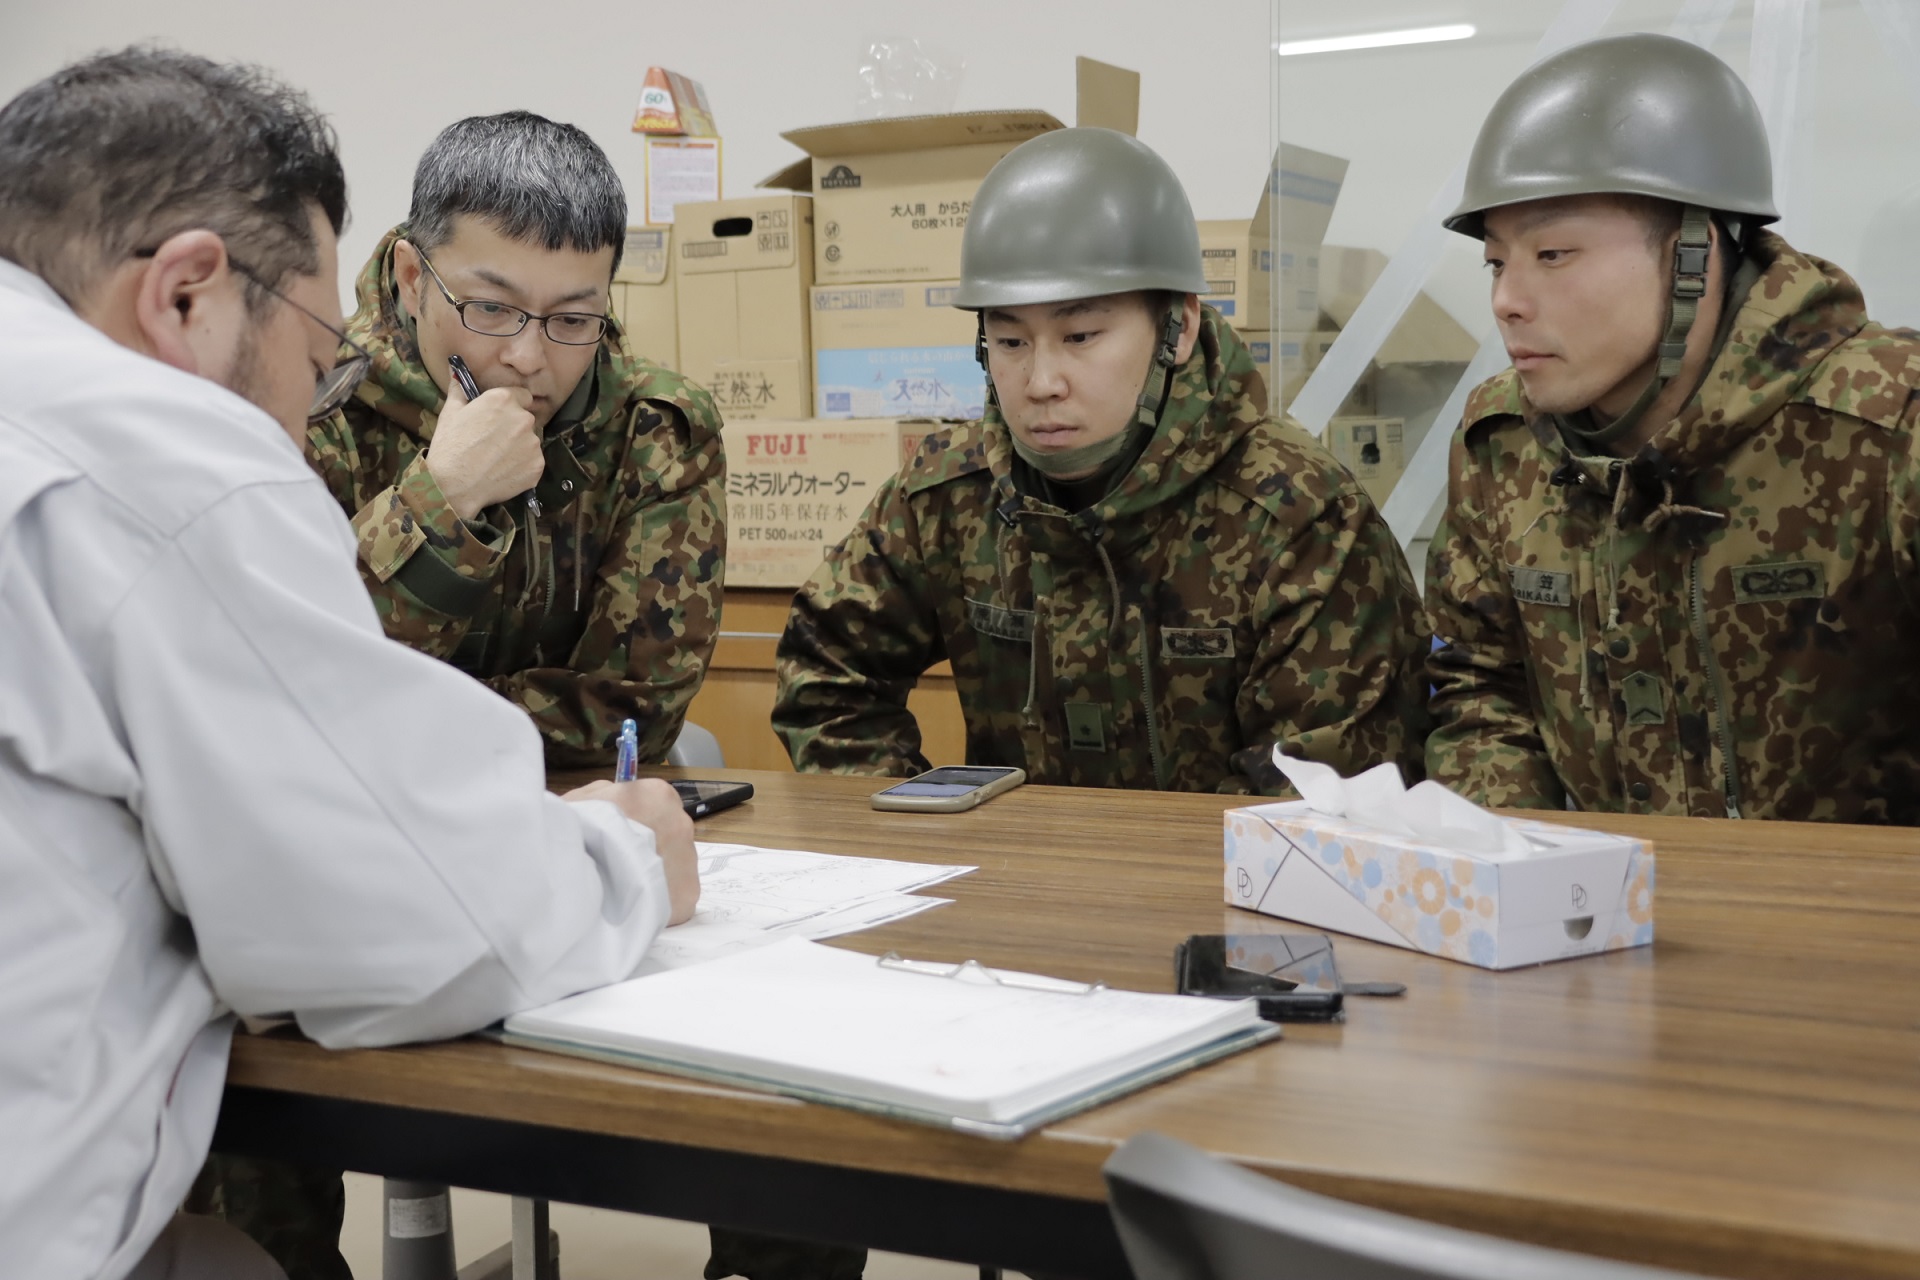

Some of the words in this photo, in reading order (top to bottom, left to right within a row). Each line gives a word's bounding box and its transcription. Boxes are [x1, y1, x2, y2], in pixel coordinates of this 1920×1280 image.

[891, 204, 926, 217] 大人用
[707, 379, 776, 404] 天然水
[893, 378, 951, 401] 天然水
[746, 434, 807, 455] FUJI
[726, 471, 866, 496] ミネラルウォーター
[739, 528, 762, 540] PET
